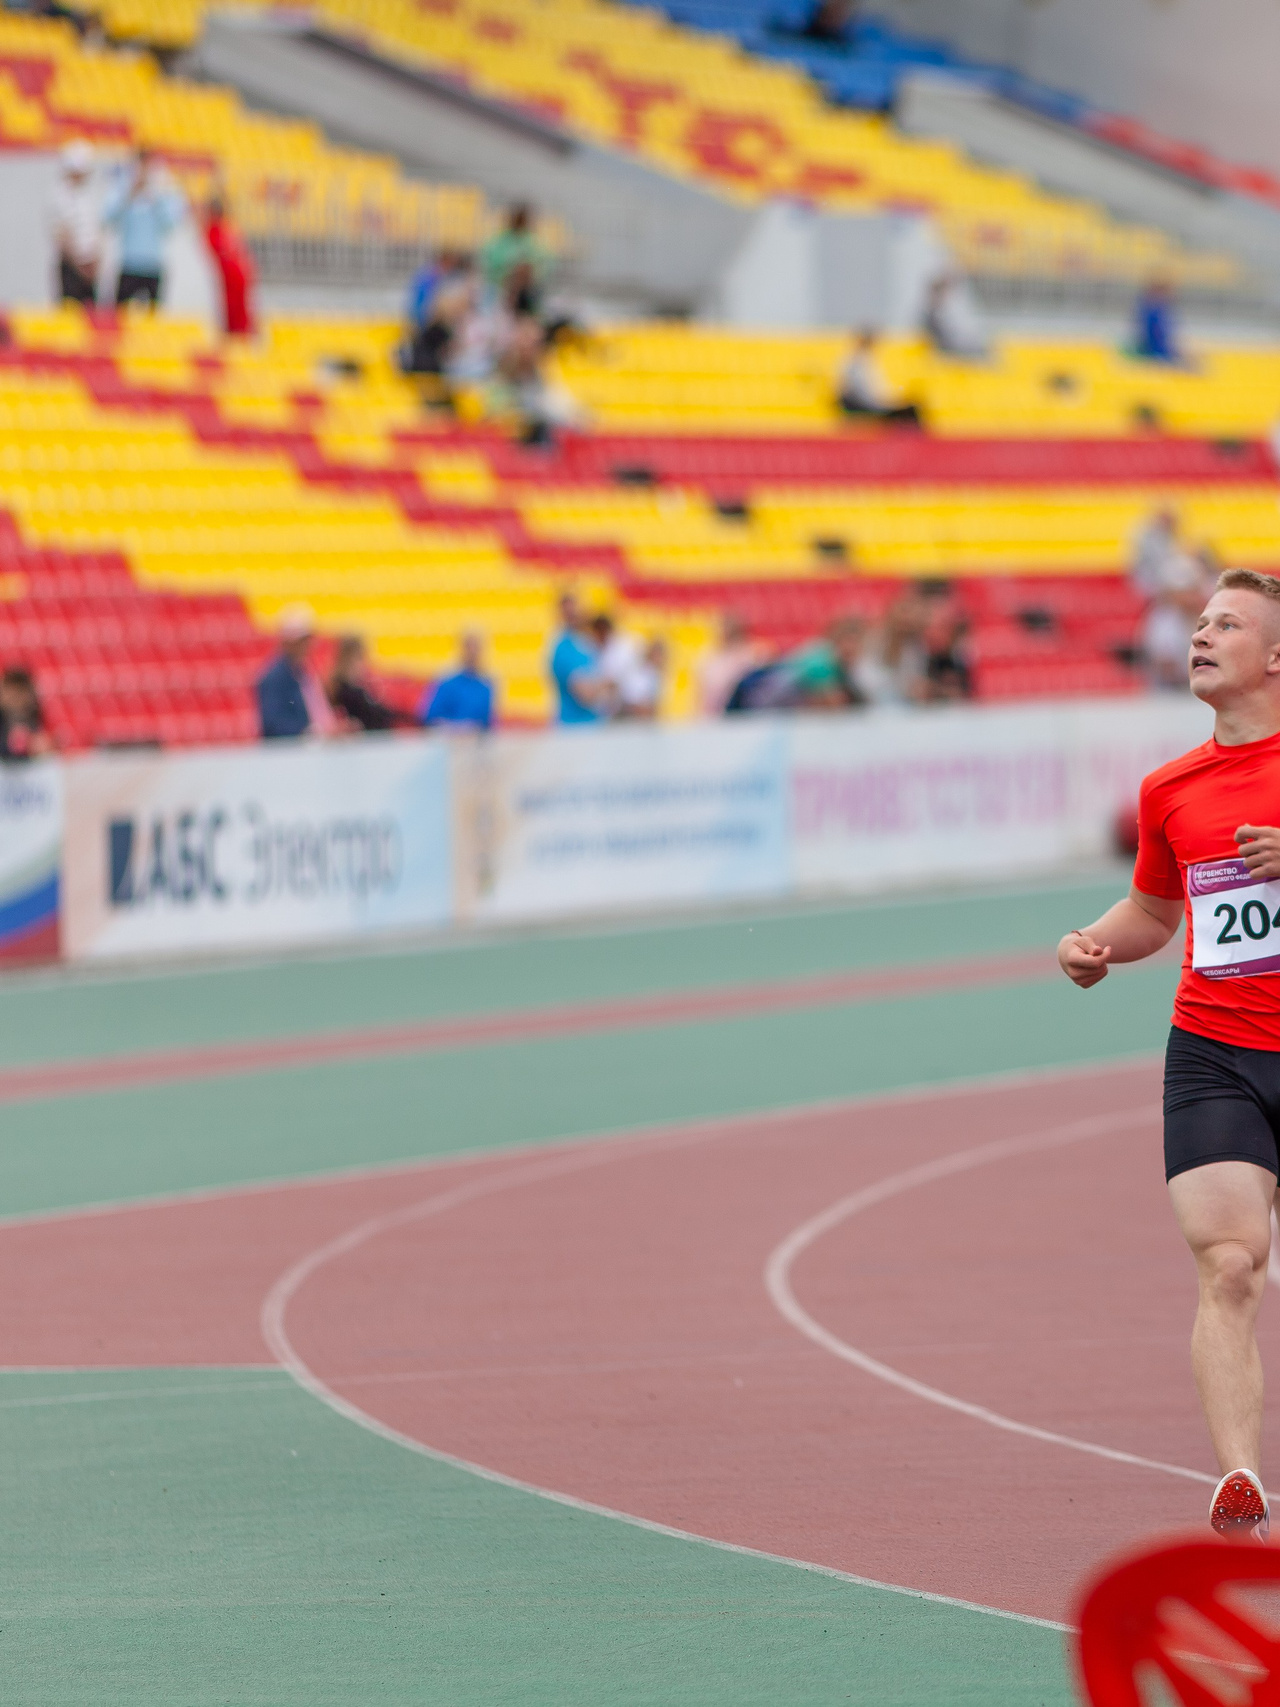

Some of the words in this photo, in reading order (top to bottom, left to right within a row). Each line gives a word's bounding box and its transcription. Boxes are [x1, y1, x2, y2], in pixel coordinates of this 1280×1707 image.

[1194, 867, 1238, 879] ПЕРВЕНСТВО
[1195, 875, 1235, 885] ПРИВОЛЖСКОГО
[1201, 967, 1240, 976] ЧЕБОКСАРЫ
